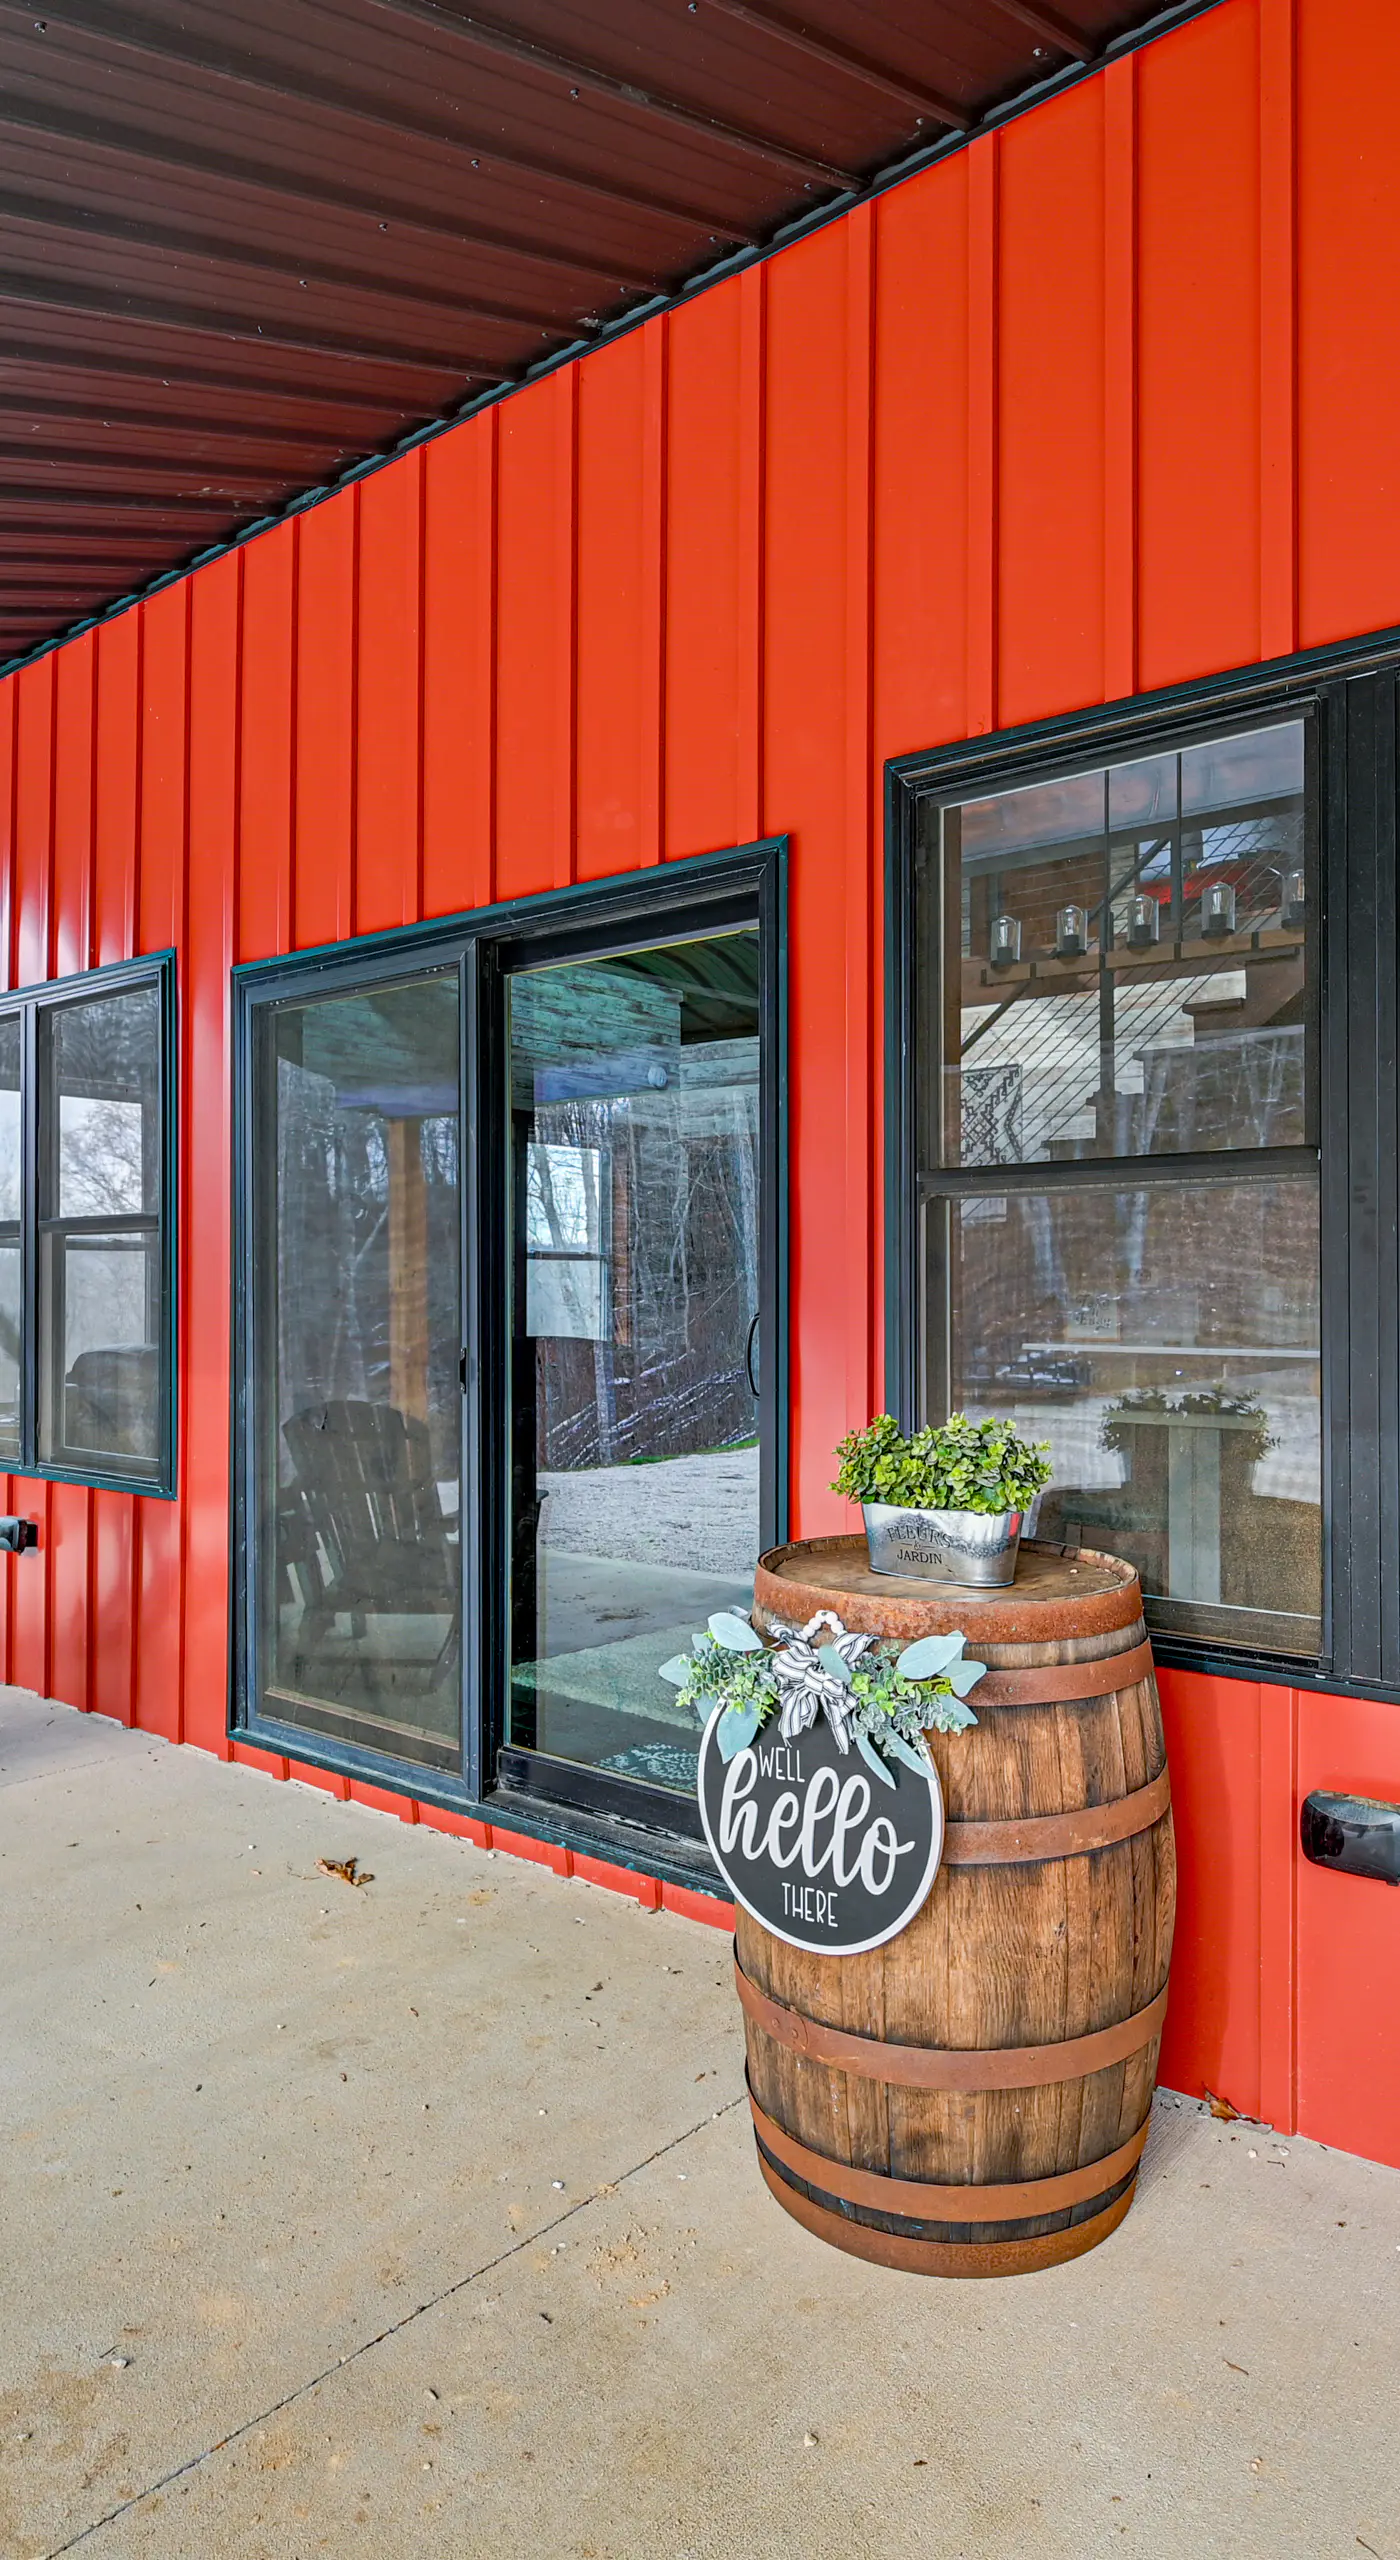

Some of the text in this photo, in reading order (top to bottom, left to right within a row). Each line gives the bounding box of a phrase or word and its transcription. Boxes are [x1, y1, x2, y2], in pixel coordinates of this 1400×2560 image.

[886, 1524, 952, 1549] FLEURS
[896, 1549, 943, 1565] JARDIN
[758, 1744, 805, 1783] WELL
[719, 1747, 916, 1896] hello
[781, 1882, 839, 1928] THERE
